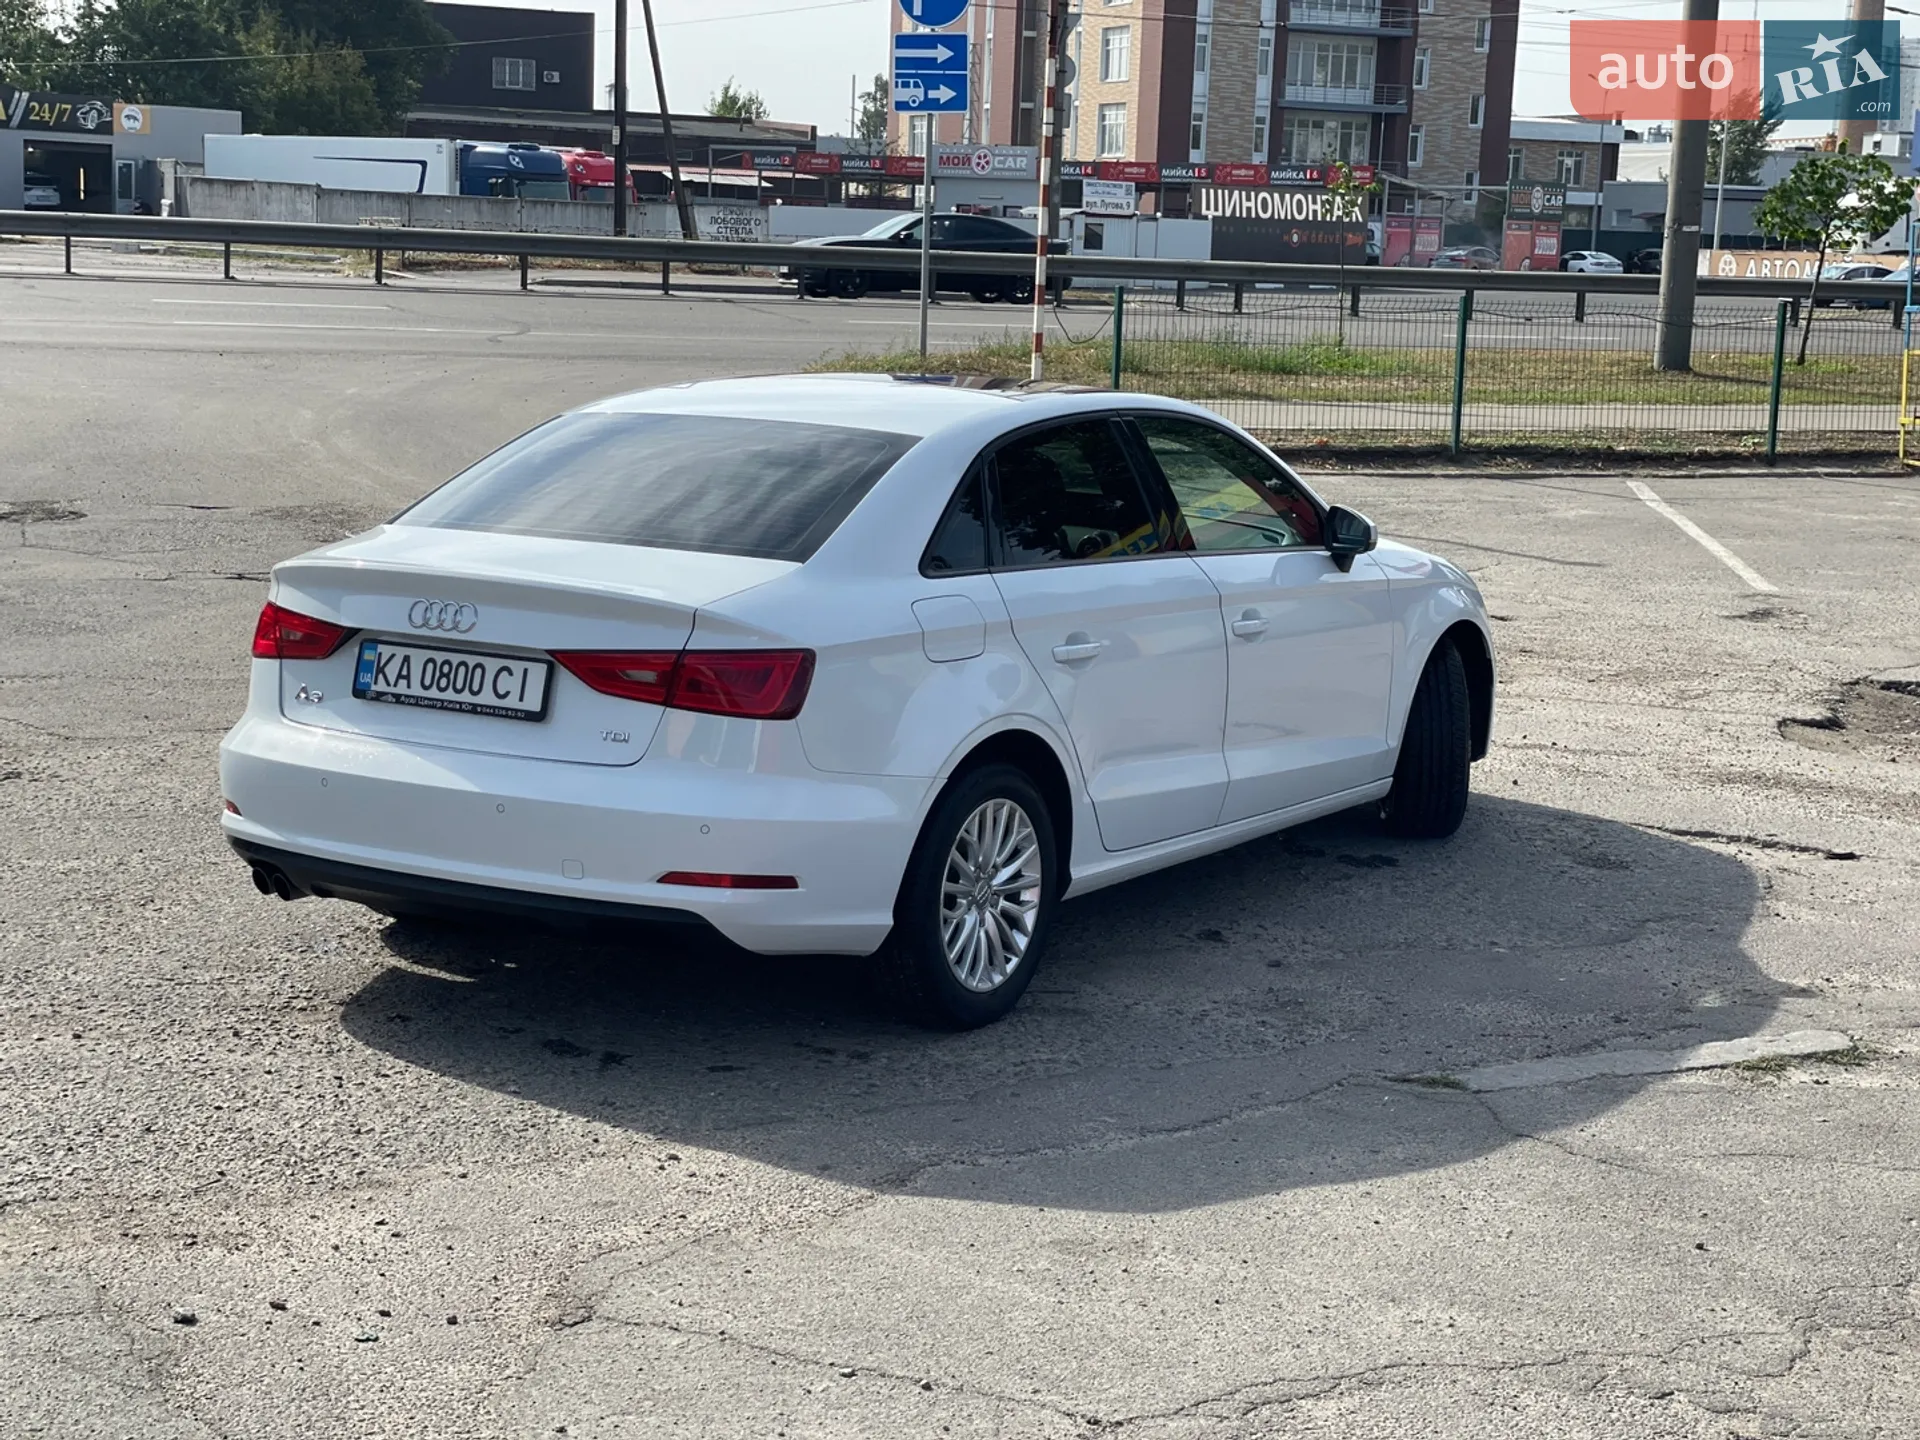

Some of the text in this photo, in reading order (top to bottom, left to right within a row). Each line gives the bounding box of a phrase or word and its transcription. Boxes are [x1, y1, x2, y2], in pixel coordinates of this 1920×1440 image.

[29, 102, 72, 126] 24/7
[754, 155, 780, 165] МИЙКА
[842, 158, 870, 168] МИЙКА
[939, 154, 1027, 169] МОЙ CAR
[1161, 166, 1193, 177] МИЙКА
[1270, 168, 1305, 180] МИЙКА
[1126, 201, 1131, 211] 9
[1544, 194, 1564, 206] CAR
[709, 216, 761, 226] ЛОБОВОГО
[717, 225, 754, 236] СТЕКЛА
[359, 671, 373, 684] UA
[373, 652, 529, 703] KA 0800 CI
[294, 681, 324, 704] A3
[599, 729, 631, 744] TDI
